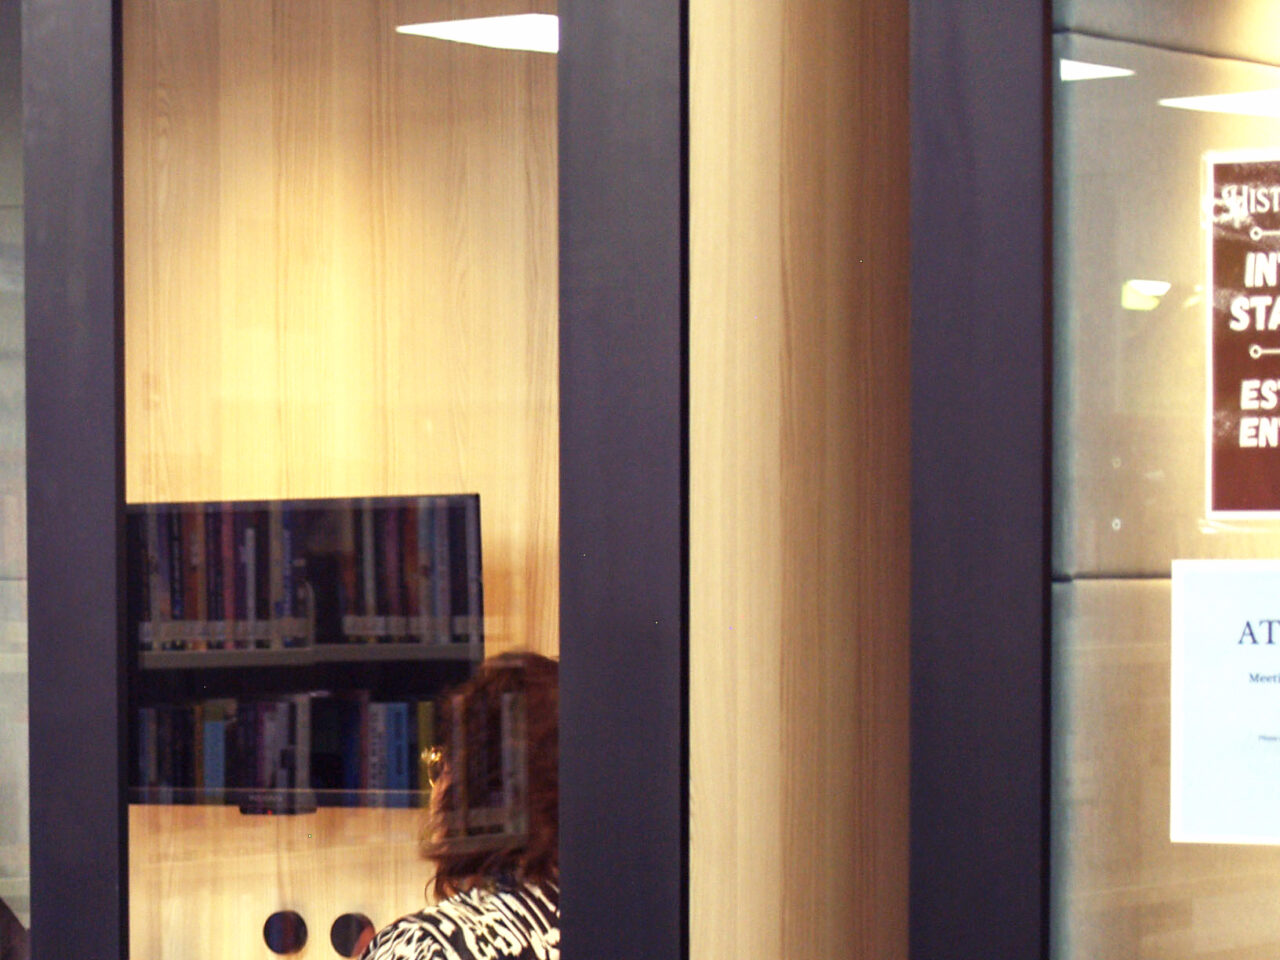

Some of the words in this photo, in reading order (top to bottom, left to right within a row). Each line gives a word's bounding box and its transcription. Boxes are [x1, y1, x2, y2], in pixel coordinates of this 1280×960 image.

[1244, 251, 1280, 288] IN
[1240, 378, 1280, 410] ES
[1239, 416, 1280, 448] EN
